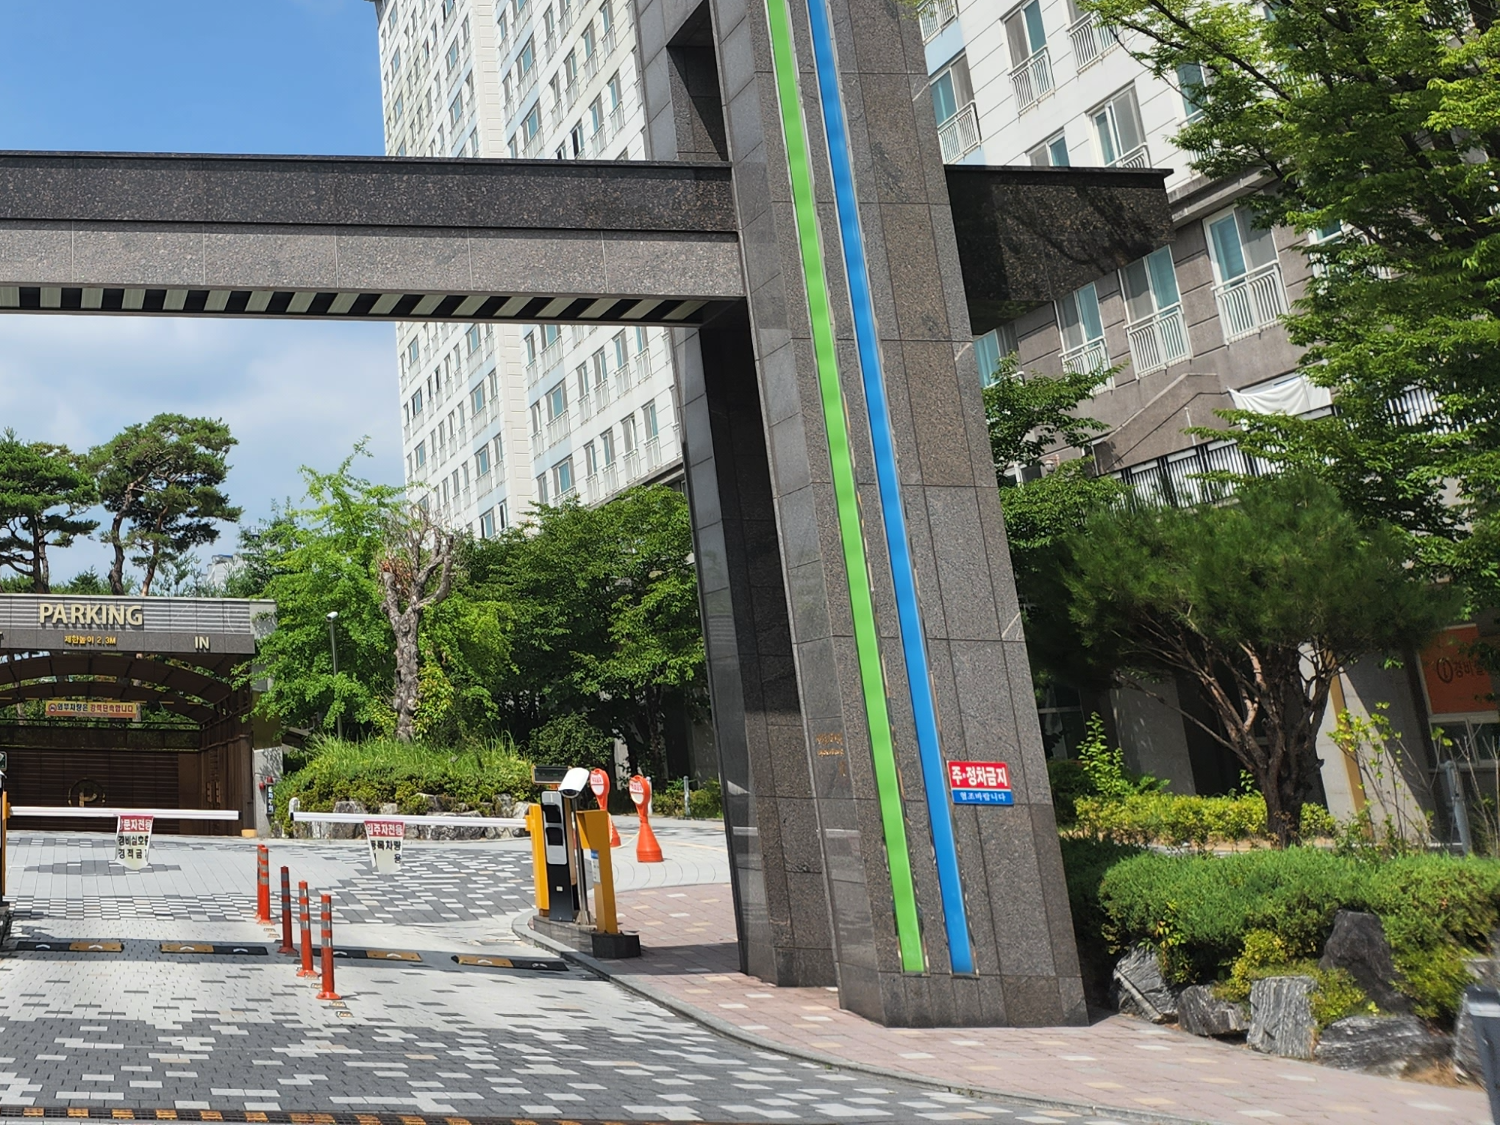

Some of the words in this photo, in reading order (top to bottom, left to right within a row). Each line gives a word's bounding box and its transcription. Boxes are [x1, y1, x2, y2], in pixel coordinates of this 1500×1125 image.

[38, 603, 143, 626] PARKING
[64, 635, 95, 645] 제한높이
[96, 636, 116, 645] 2.3M
[194, 636, 210, 649] IN
[120, 819, 152, 831] 문자전용
[367, 824, 402, 835] 입주자전용
[119, 848, 147, 859] 경적금
